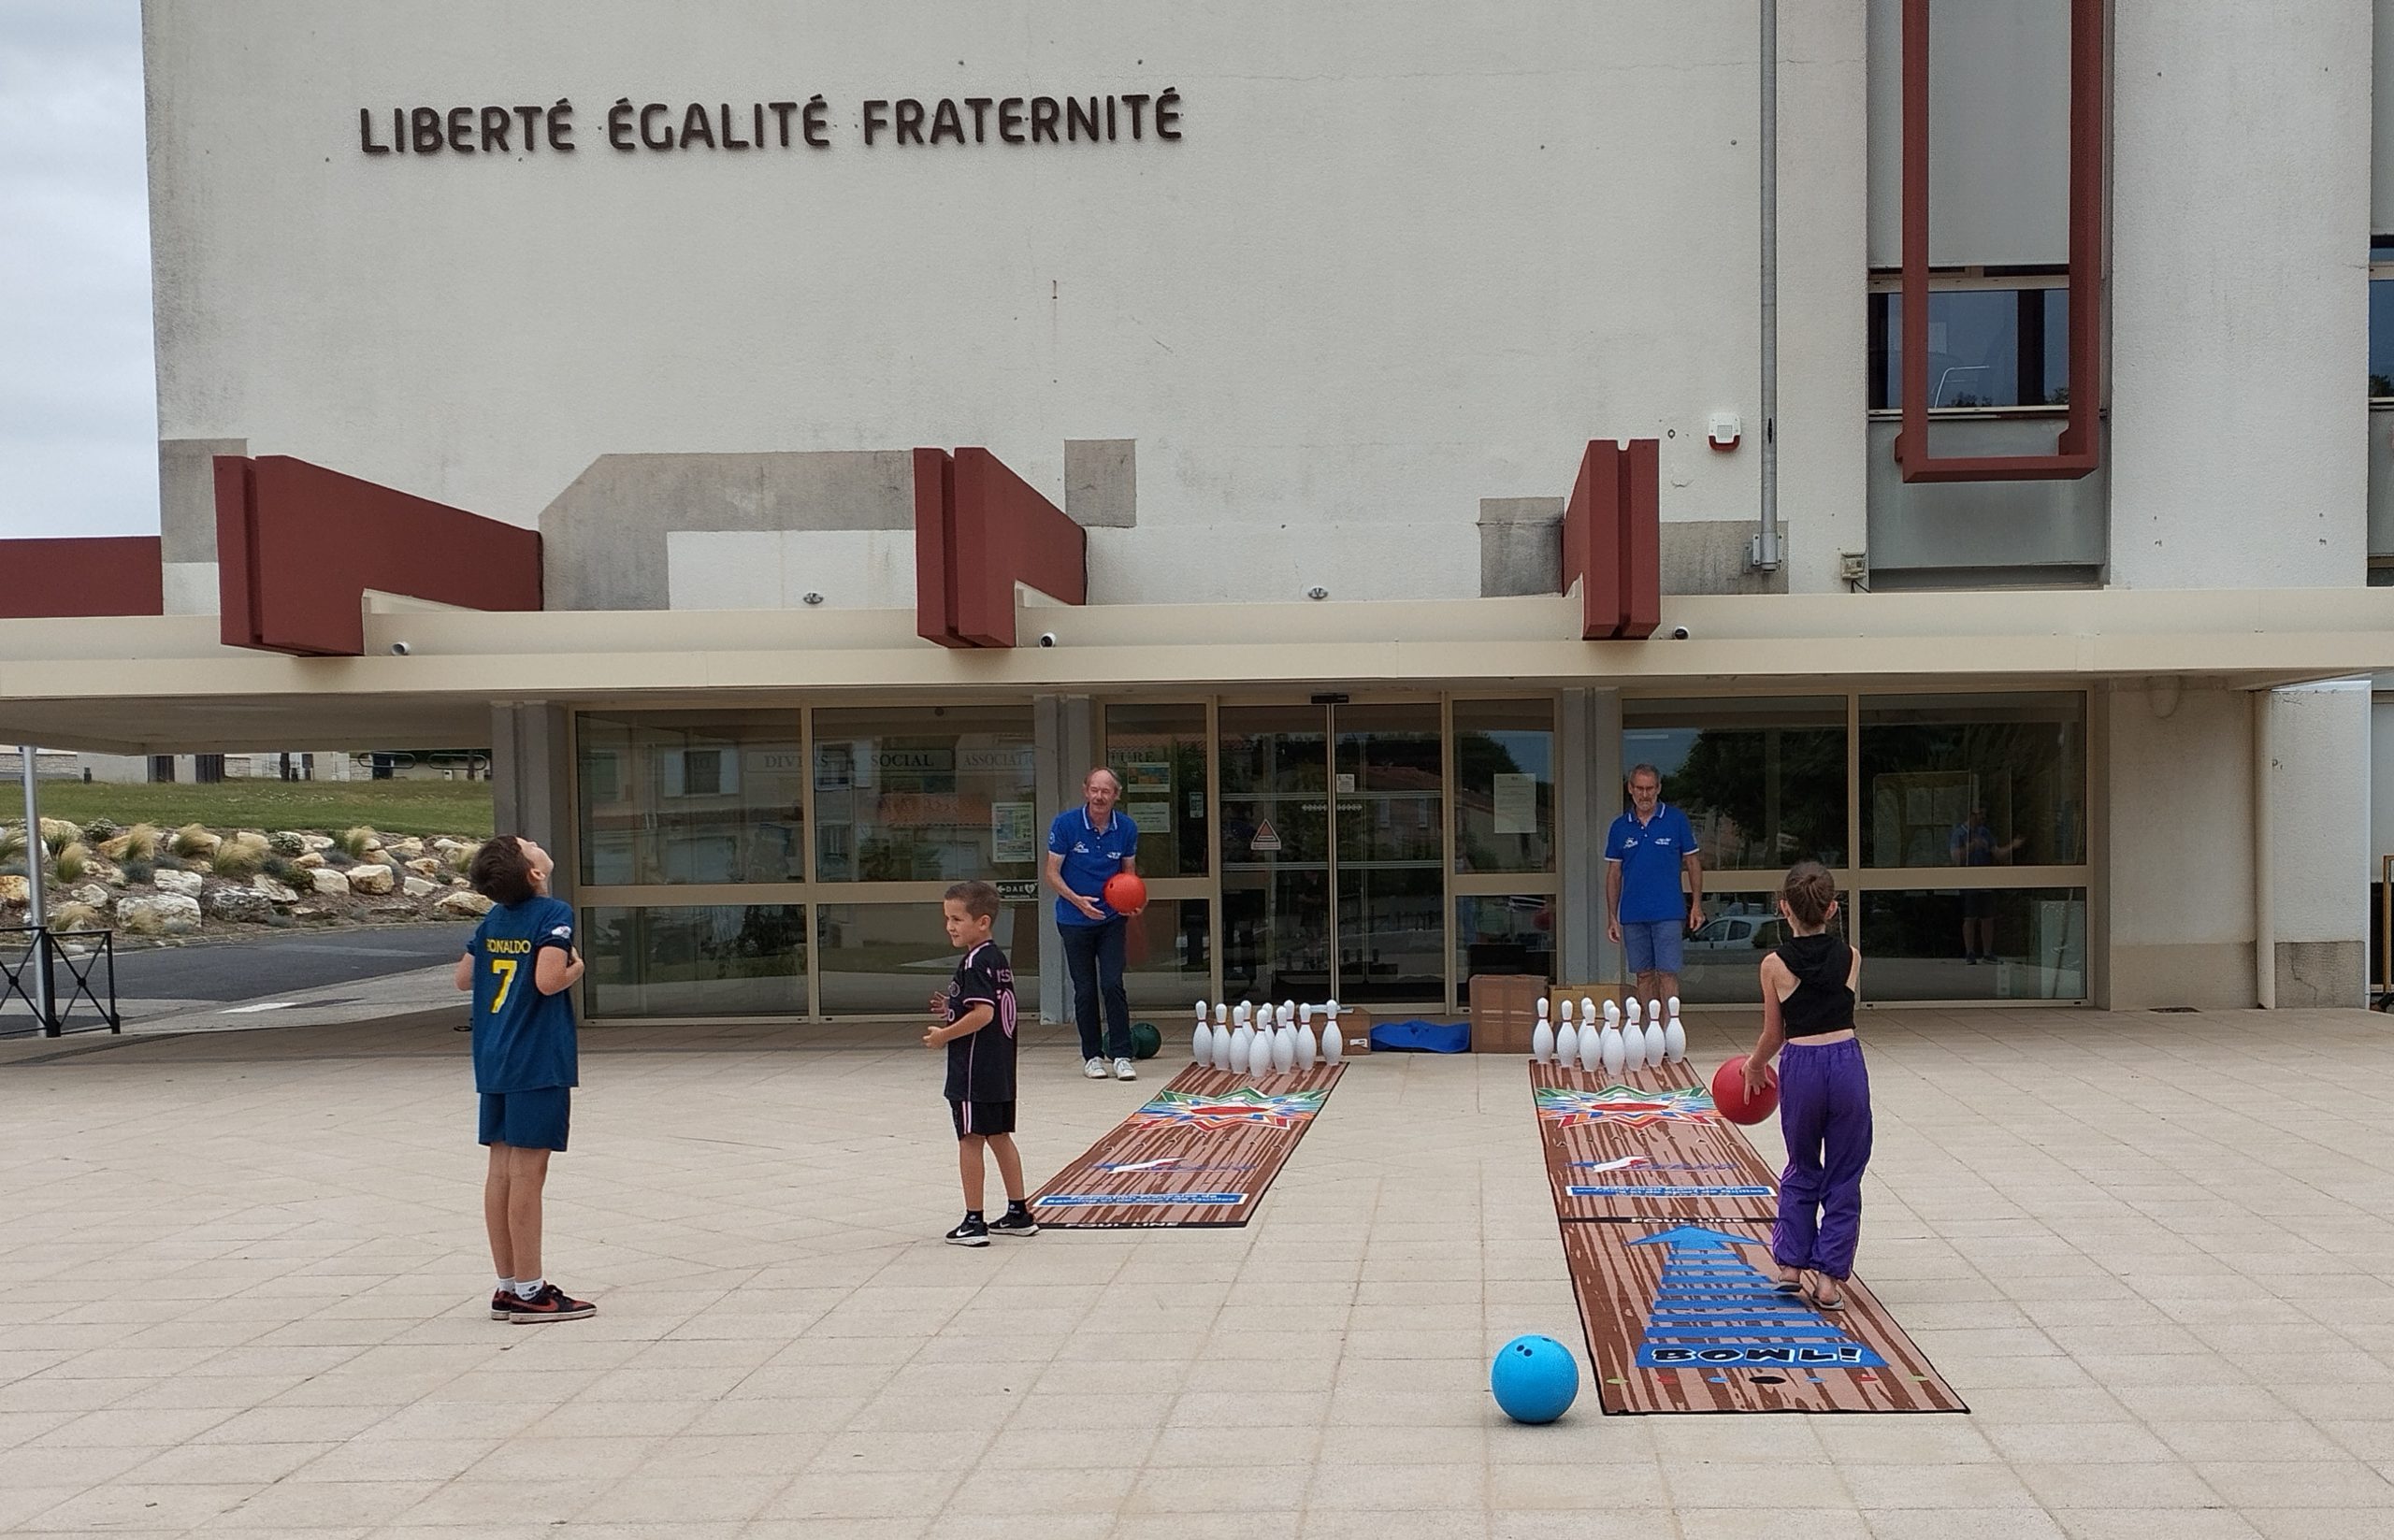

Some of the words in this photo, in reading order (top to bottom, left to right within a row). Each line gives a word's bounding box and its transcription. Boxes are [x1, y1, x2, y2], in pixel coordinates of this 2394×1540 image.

[360, 97, 576, 152] LIBERTÉ
[608, 94, 829, 150] ÉGALITÉ
[863, 87, 1182, 145] FRATERNITÉ
[871, 753, 934, 768] SOCIAL
[490, 958, 517, 1014] 7
[1651, 1346, 1862, 1363] BOWL!
